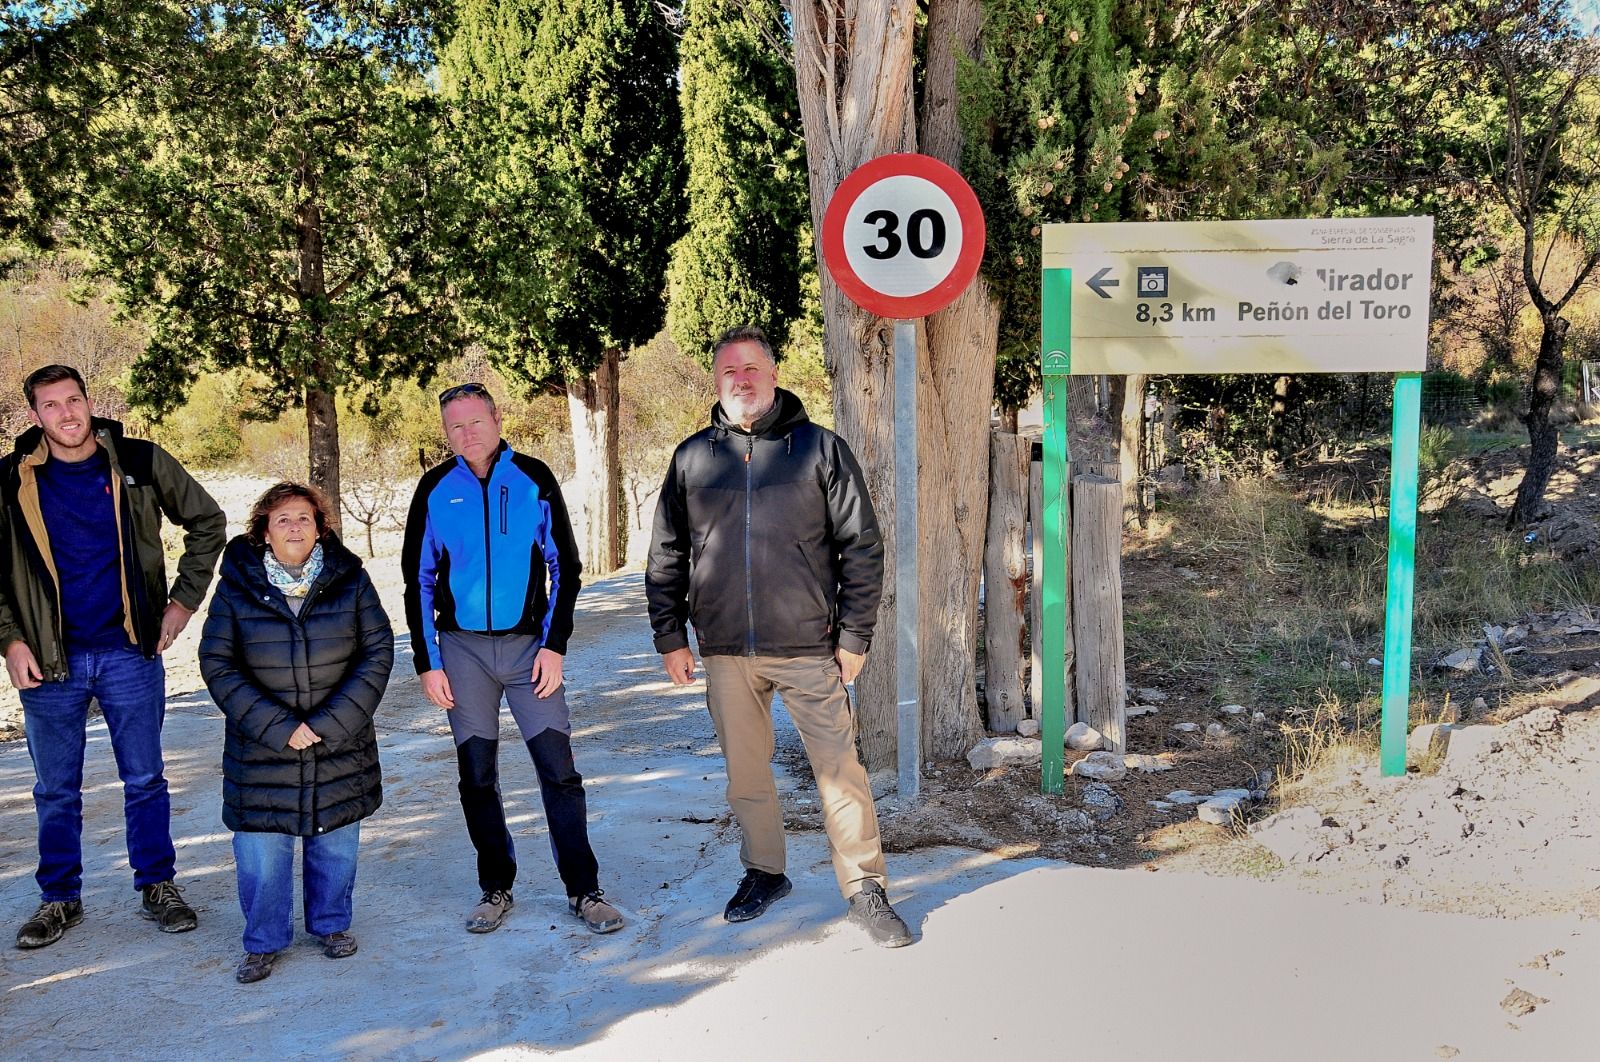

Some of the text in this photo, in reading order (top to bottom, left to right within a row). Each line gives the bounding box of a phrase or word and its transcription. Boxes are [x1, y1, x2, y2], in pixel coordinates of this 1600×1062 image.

[863, 208, 946, 260] 30
[1321, 235, 1352, 245] Sierra
[1355, 234, 1369, 244] de
[1371, 234, 1384, 244] La
[1136, 302, 1216, 326] 8,3 km
[1238, 300, 1412, 321] Peñón del Toro
